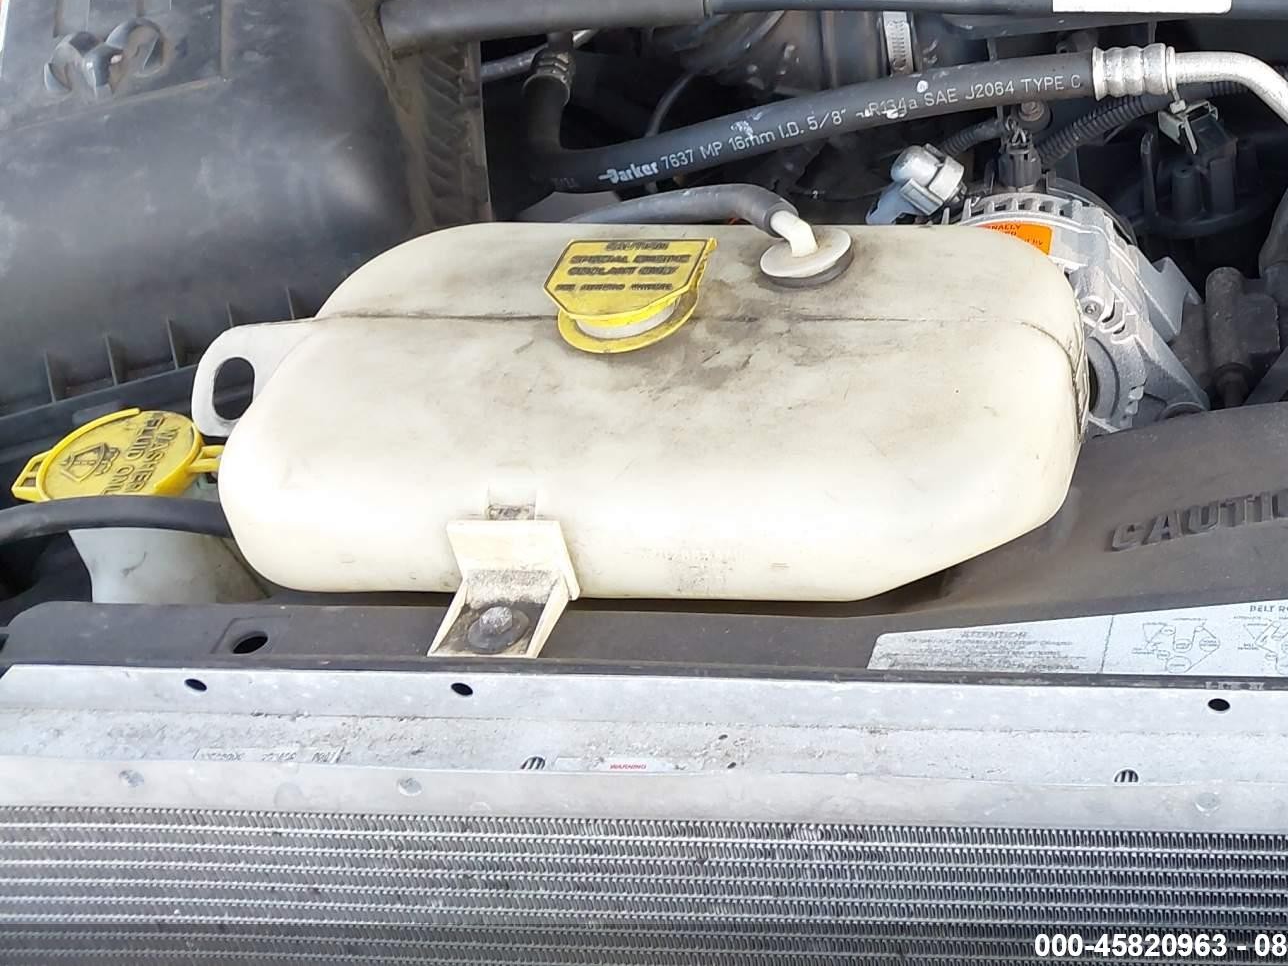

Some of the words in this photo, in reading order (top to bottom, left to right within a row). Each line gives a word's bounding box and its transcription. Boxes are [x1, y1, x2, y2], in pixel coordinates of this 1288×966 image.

[661, 149, 695, 171] 7637
[700, 141, 723, 160] MP
[728, 131, 776, 152] 16mm
[924, 88, 958, 107] SAE
[965, 80, 1014, 101] J2064
[1021, 75, 1065, 92] TYPE
[1070, 74, 1081, 89] C
[1249, 604, 1277, 613] BELT
